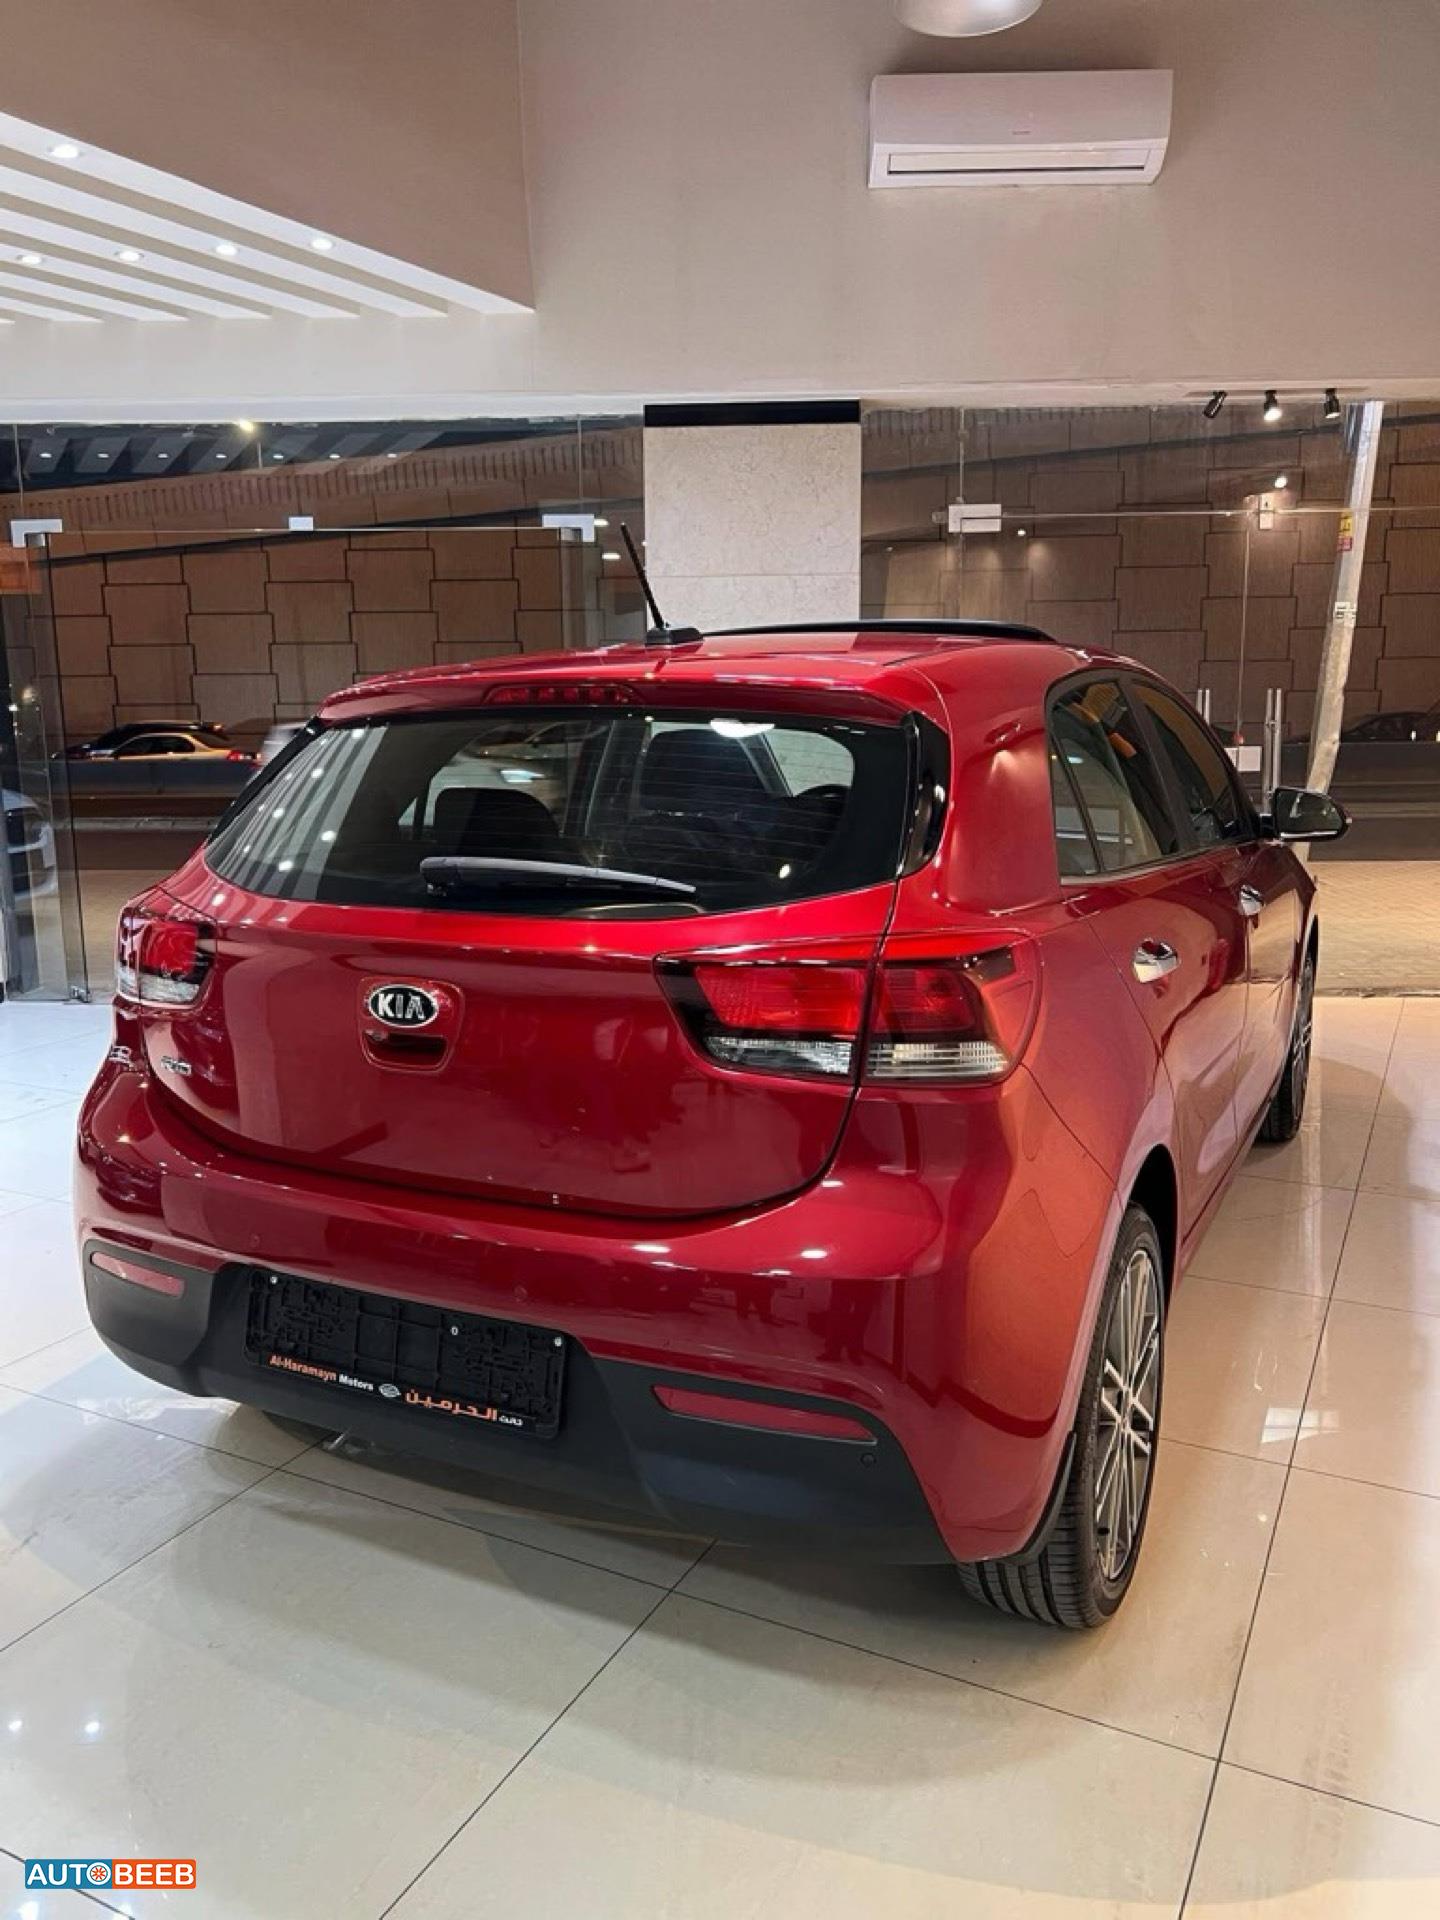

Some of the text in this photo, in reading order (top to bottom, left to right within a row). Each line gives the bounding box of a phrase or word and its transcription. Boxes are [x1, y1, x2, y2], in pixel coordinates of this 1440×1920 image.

[378, 992, 426, 1020] KIA
[269, 1355, 337, 1382] Al-Haramayn
[339, 1374, 374, 1391] Motors
